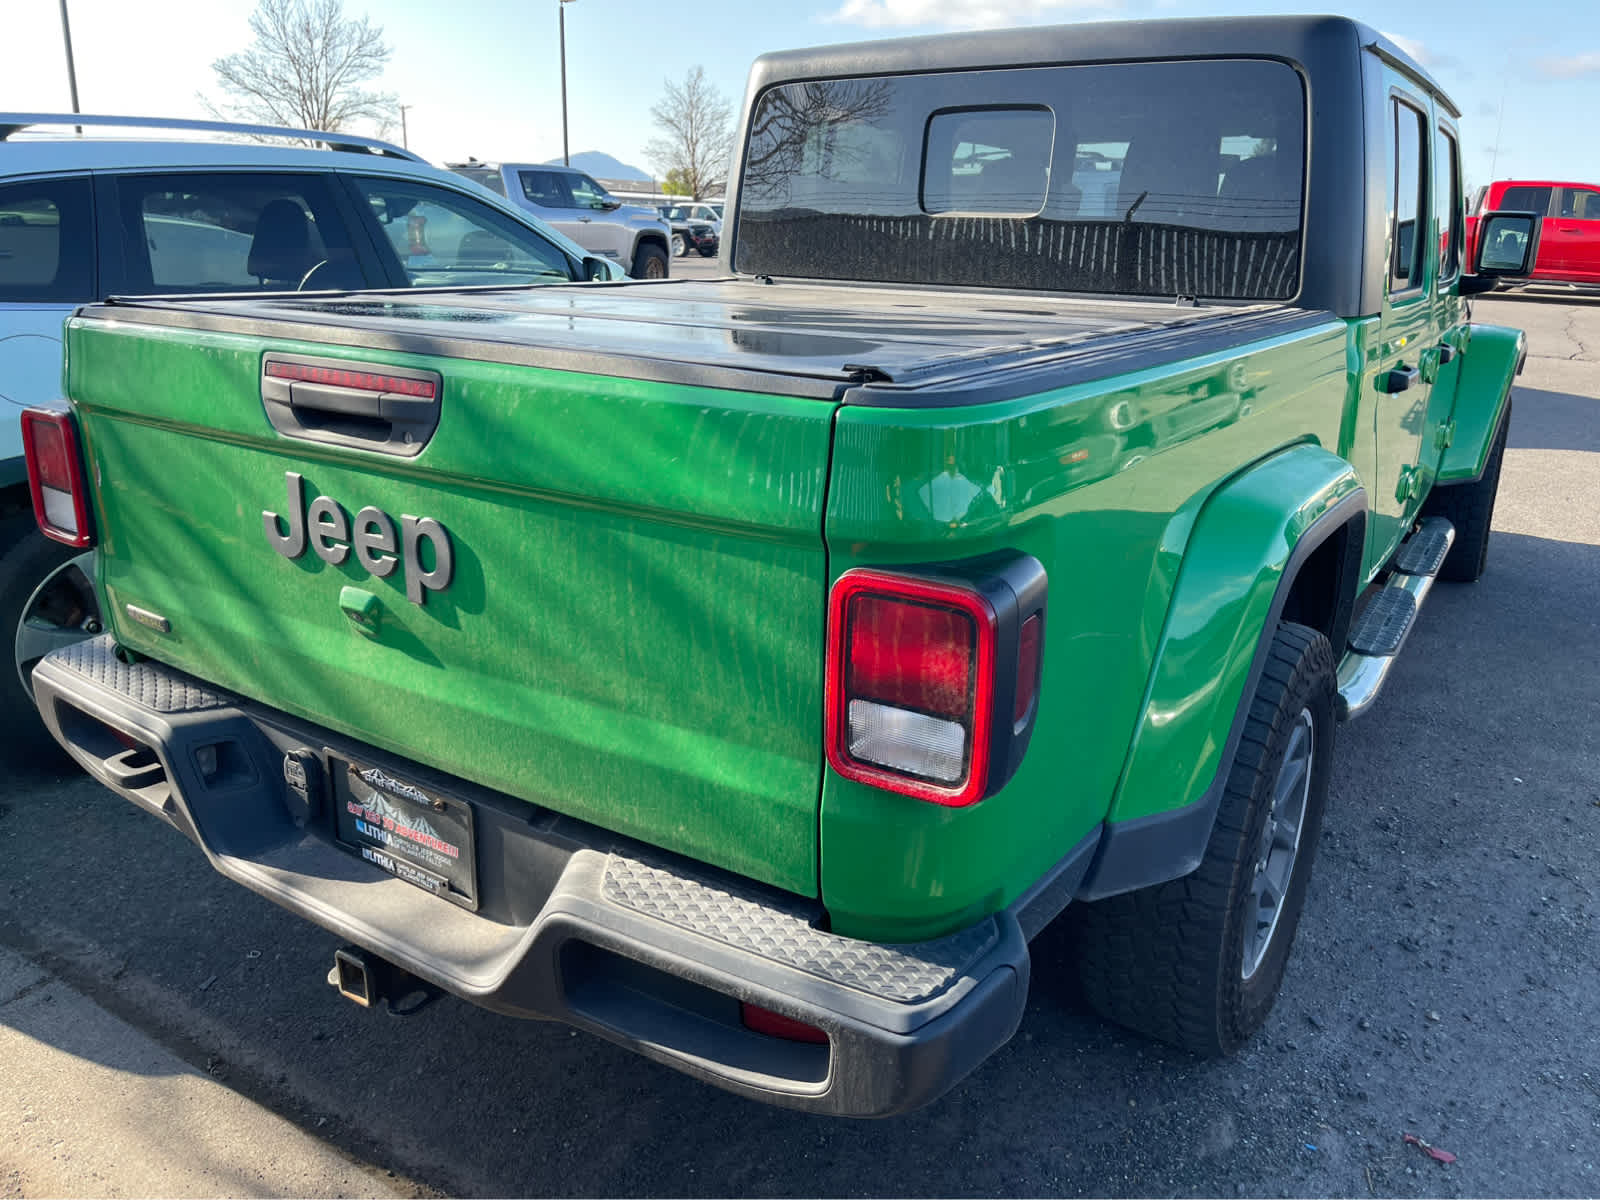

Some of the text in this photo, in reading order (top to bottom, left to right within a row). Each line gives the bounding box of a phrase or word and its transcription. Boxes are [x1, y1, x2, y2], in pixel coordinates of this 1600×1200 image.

[262, 471, 455, 606] Jeep
[347, 801, 363, 817] SAY
[365, 808, 380, 825] YES
[382, 815, 394, 831] TO
[364, 822, 394, 847] LITHIA
[370, 851, 395, 872] LITHIA
